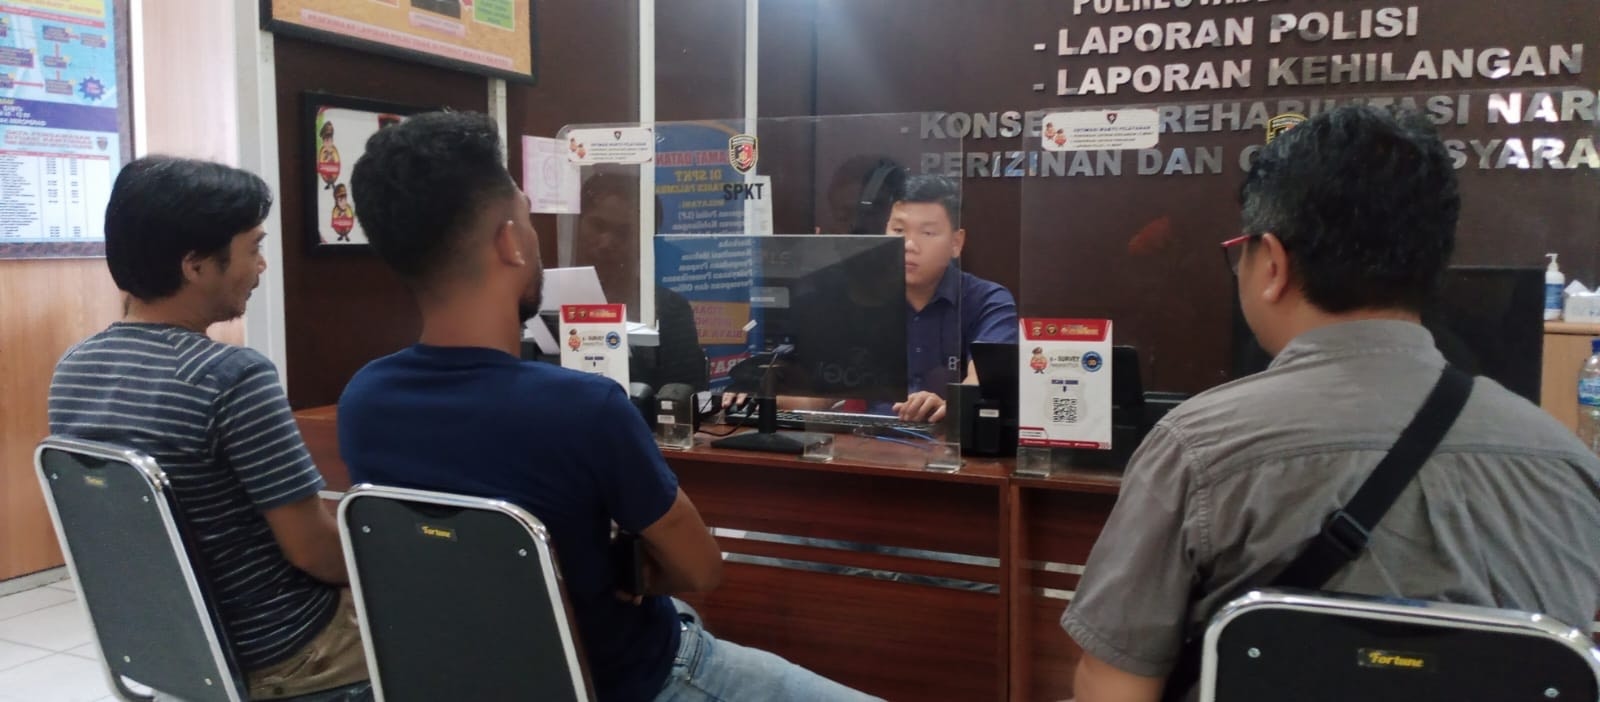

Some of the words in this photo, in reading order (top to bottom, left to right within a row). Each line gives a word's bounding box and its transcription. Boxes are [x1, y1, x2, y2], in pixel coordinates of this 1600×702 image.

[1058, 17, 1254, 56] LAPORAN
[1269, 6, 1419, 43] POLISI
[1057, 59, 1252, 95] LAPORAN
[1267, 44, 1584, 87] KEHILANGAN
[919, 109, 1047, 139] KONSE
[1488, 90, 1600, 124] NAR
[920, 150, 1123, 178] PERIZINAN
[1137, 145, 1223, 175] DAN
[1446, 137, 1600, 170] SYARA
[723, 183, 765, 201] SPKT
